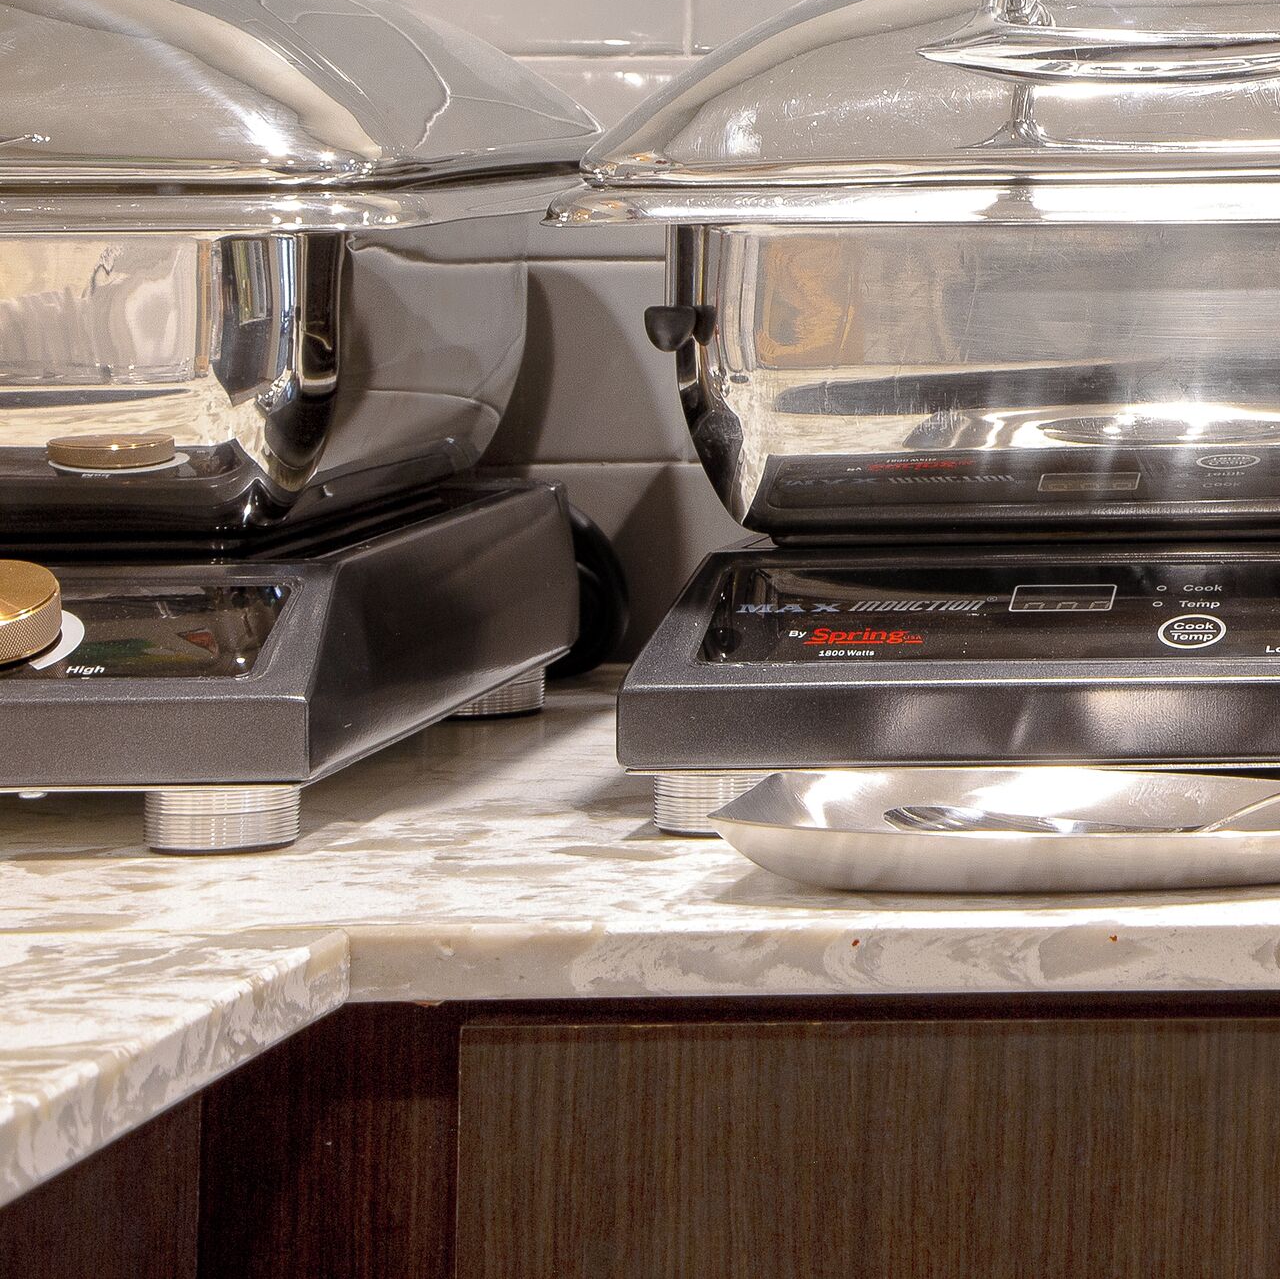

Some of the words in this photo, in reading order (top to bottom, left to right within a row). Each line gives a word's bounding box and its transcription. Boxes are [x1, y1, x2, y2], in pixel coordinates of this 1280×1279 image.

[1183, 584, 1223, 592] Cook
[736, 602, 841, 614] MAX
[1179, 600, 1220, 609] Temp
[1173, 621, 1214, 630] Cook
[788, 629, 807, 639] By
[808, 627, 909, 645] Spring
[1171, 632, 1213, 642] Temp
[818, 649, 845, 657] 1800
[847, 649, 875, 657] Watts
[66, 665, 105, 675] High
